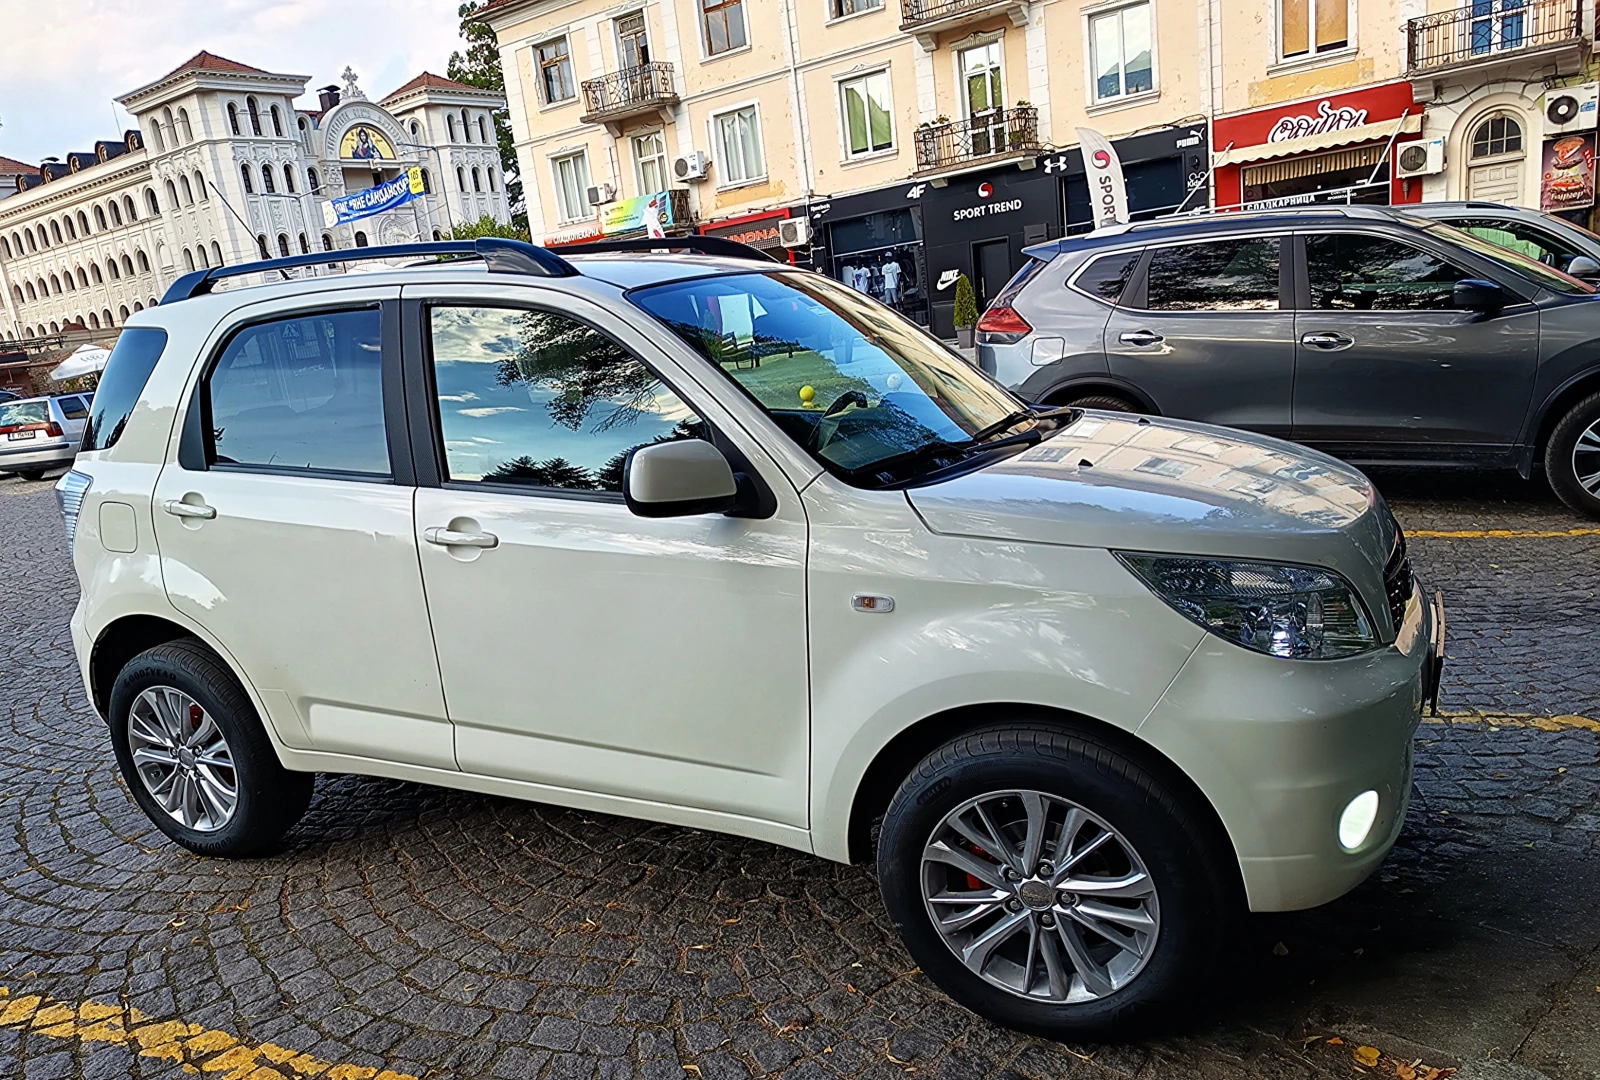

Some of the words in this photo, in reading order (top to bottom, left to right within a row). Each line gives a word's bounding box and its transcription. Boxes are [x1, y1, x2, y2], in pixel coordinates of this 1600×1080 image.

[1176, 136, 1200, 149] PUMA
[906, 184, 927, 199] 4F
[953, 205, 987, 221] SPORT
[987, 199, 1023, 215] TREND
[1246, 194, 1316, 211] СЛАДКАРНИЦА
[940, 269, 960, 281] NIKE
[124, 667, 177, 687] GOODYEAR
